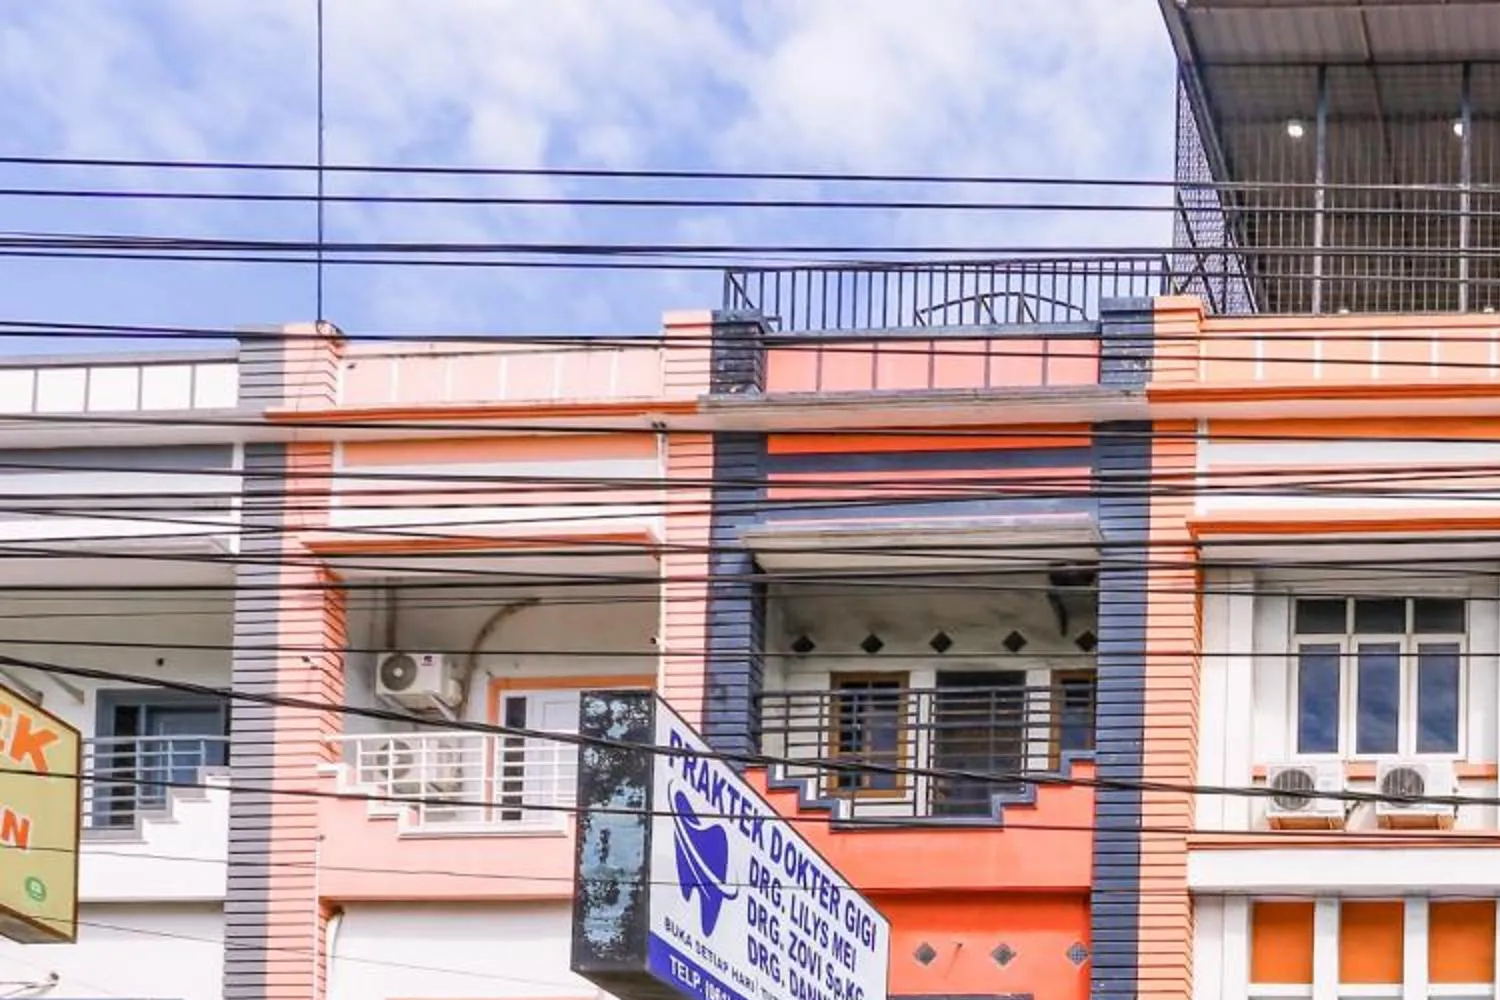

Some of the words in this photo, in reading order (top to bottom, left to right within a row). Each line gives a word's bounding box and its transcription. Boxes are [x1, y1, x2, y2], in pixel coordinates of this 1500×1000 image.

[669, 728, 764, 850] PRAKTEK
[769, 825, 841, 920] DOKTER
[845, 900, 877, 952] GIGI
[747, 896, 784, 950] DRG.
[788, 930, 822, 981] ZOVI
[747, 933, 785, 987] DRG.
[749, 856, 785, 913] DRG.
[790, 893, 829, 949] LILYS
[831, 931, 857, 973] MEI
